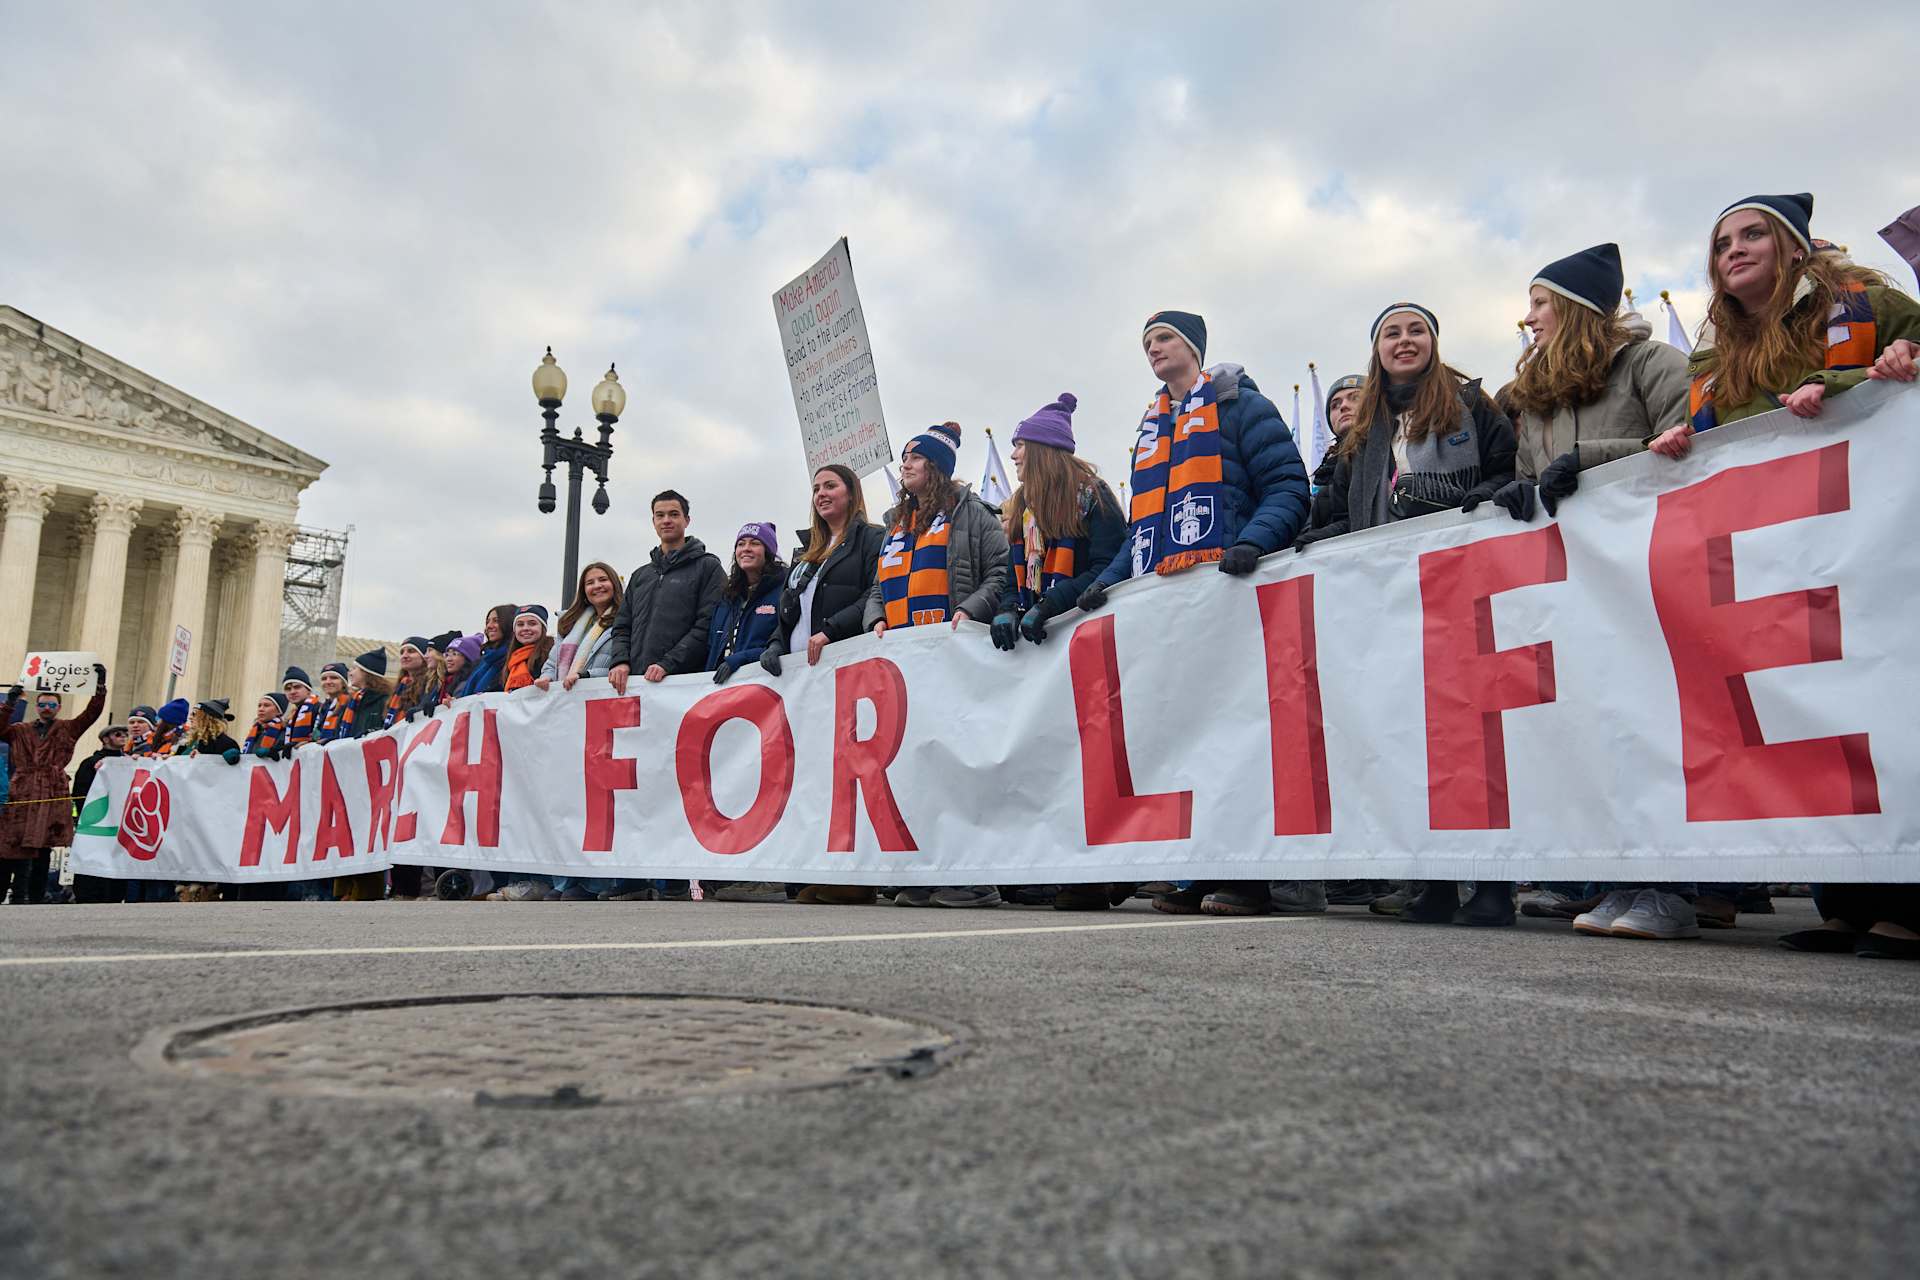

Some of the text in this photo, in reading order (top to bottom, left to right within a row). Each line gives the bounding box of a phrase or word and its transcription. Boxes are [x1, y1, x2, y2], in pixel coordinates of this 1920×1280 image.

[779, 257, 840, 319] Make America
[792, 289, 842, 344] good again
[786, 343, 807, 367] Good
[817, 325, 831, 347] the
[832, 306, 858, 338] unborn
[826, 336, 858, 367] mothers
[239, 440, 1882, 868] MARCH FOR LIFE
[36, 675, 71, 693] Life
